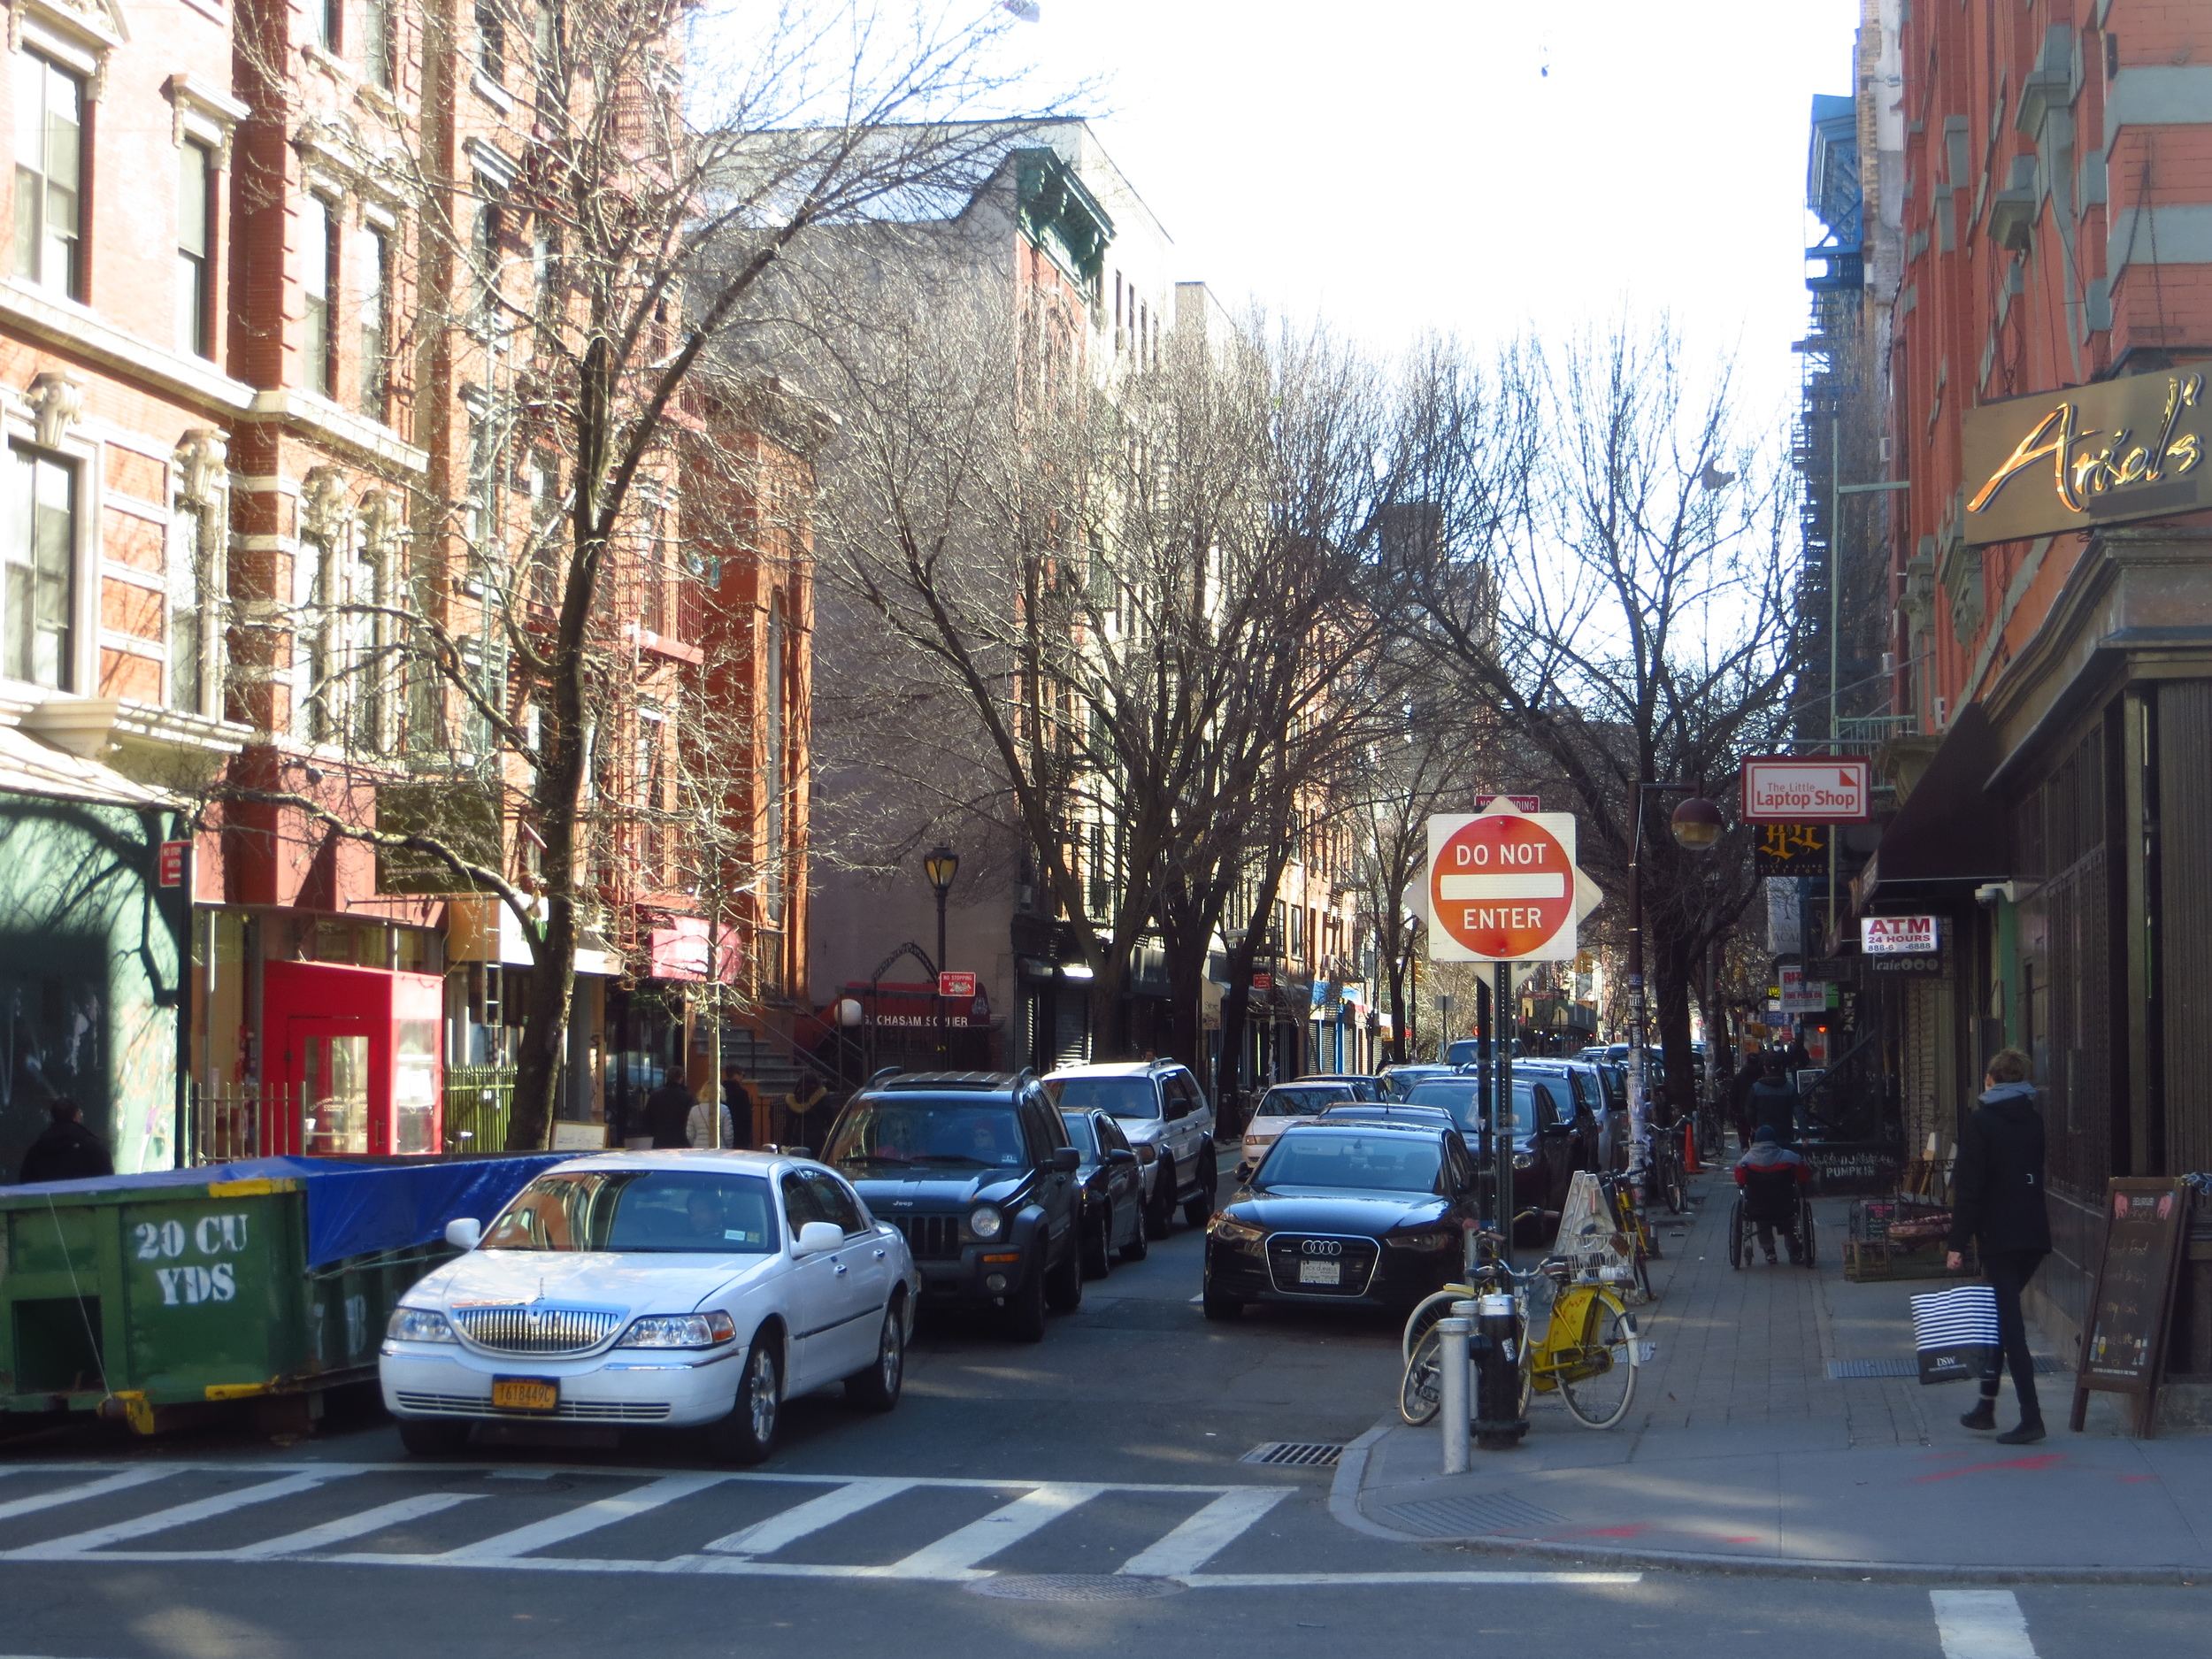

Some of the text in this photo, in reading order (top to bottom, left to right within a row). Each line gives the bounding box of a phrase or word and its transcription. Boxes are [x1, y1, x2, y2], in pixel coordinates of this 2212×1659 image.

[1767, 782, 1816, 792] The Little
[1756, 789, 1855, 810] Laptop Shop
[1456, 843, 1547, 866] DO NOT
[1463, 908, 1542, 930] ENTER
[1868, 918, 1931, 934] ATM
[1886, 934, 1931, 943] HOURS
[876, 1015, 922, 1026] CHASAM
[1826, 1166, 1875, 1178] PUMPKIN
[134, 1213, 249, 1260] 20 CU
[156, 1263, 236, 1306] YDS
[1936, 1356, 1956, 1367] DSW
